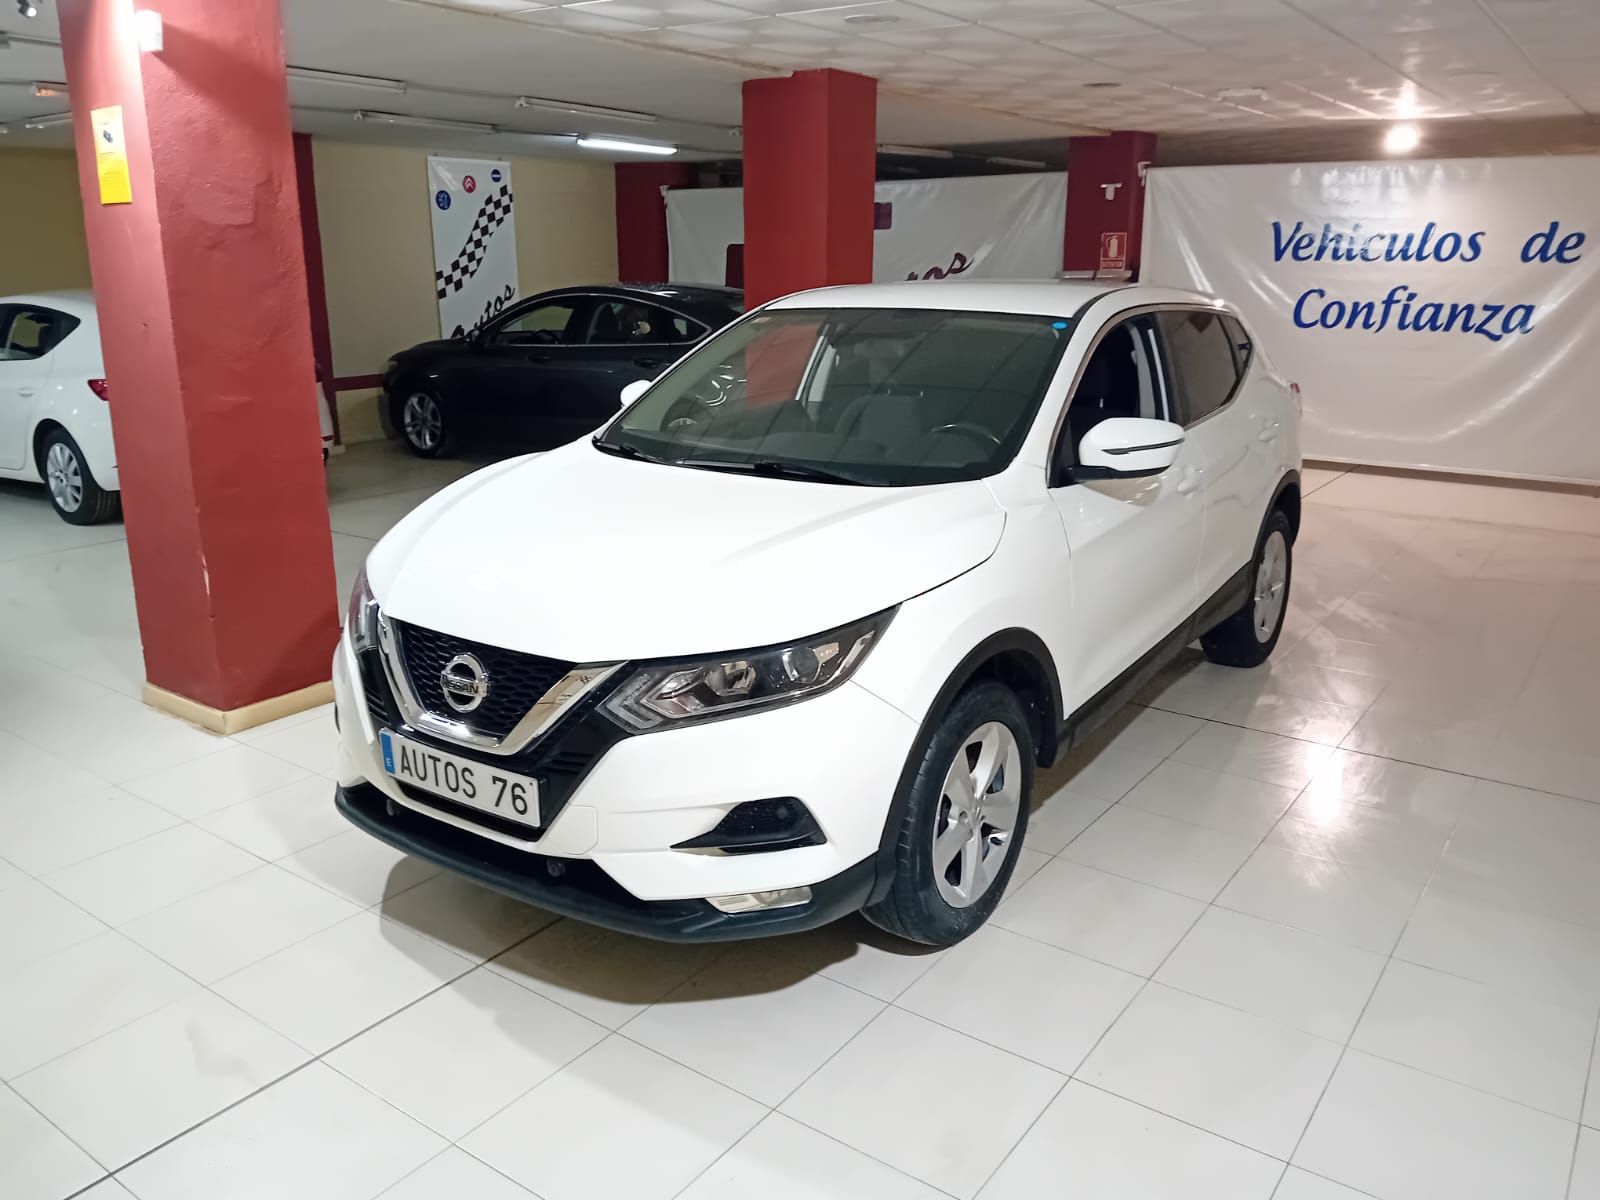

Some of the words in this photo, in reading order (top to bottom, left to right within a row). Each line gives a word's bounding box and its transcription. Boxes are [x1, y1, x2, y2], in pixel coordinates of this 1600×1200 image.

[1520, 221, 1586, 264] de
[1293, 285, 1536, 342] Confianza
[400, 744, 477, 799] AUTOS
[491, 775, 528, 815] 76
